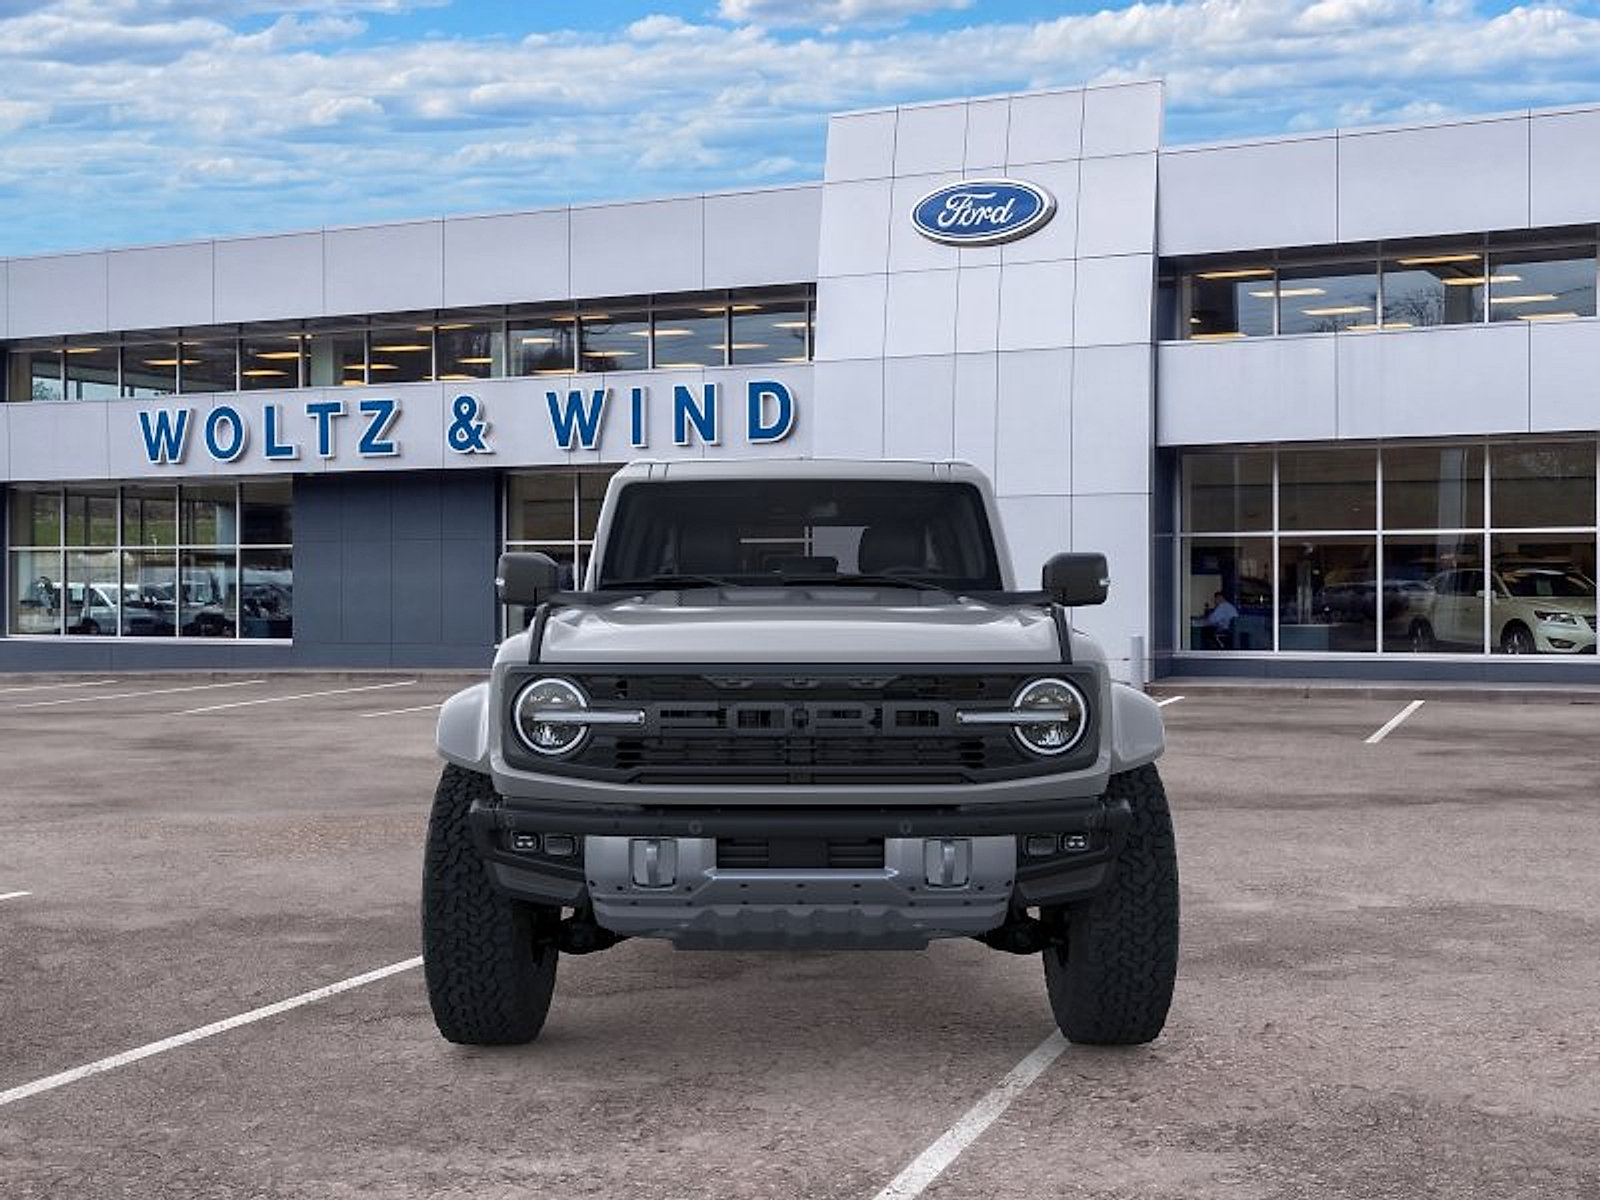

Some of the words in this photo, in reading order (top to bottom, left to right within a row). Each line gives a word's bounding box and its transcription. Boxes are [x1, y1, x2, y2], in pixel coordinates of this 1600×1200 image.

[937, 192, 1015, 228] Ford
[138, 399, 399, 463] WOLTZ
[447, 395, 494, 454] &
[545, 380, 796, 450] WIND
[650, 701, 953, 737] FORD
